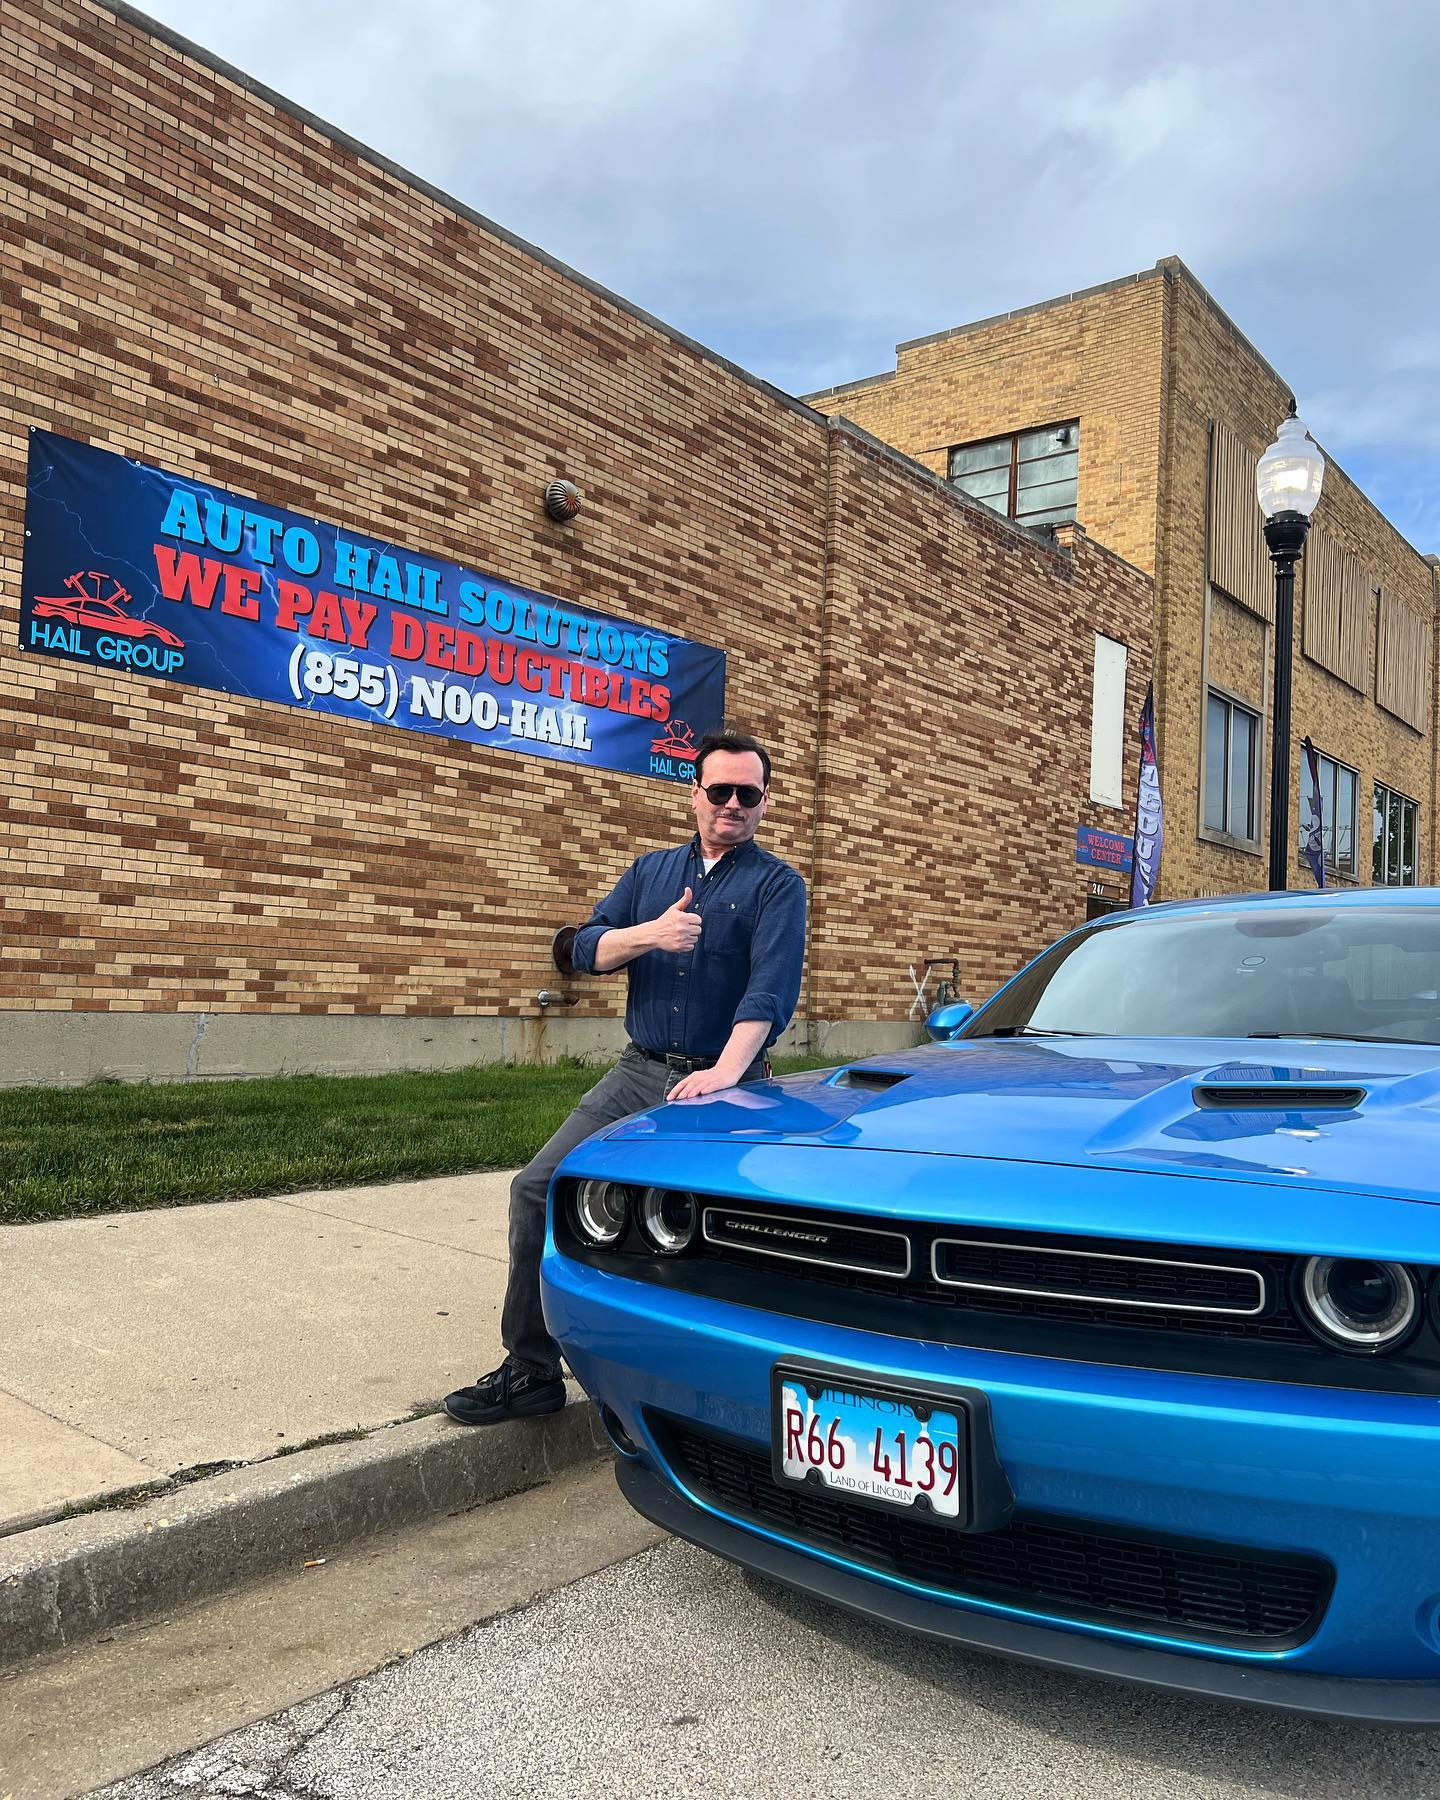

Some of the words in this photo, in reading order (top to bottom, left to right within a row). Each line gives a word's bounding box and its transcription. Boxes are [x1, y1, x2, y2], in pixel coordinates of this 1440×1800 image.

[161, 488, 321, 576] AUTO
[334, 539, 449, 616] HAIL
[459, 581, 669, 678] SOLUTIONS
[30, 620, 91, 657] HAIL
[96, 636, 185, 674] GROUP
[153, 543, 261, 622] WE
[276, 579, 378, 649] PAY
[390, 611, 671, 722] DEDUCTIBLES
[288, 642, 400, 721] (855)
[410, 675, 593, 751] NOO-HAIL
[649, 755, 677, 776] HAIL
[1087, 834, 1126, 853] WELCOME
[1091, 848, 1121, 865] CENTER
[725, 1220, 829, 1243] CHALLENGER
[825, 1388, 914, 1418] ILLINOIS
[786, 1407, 846, 1470] R66
[873, 1426, 958, 1497] 4139
